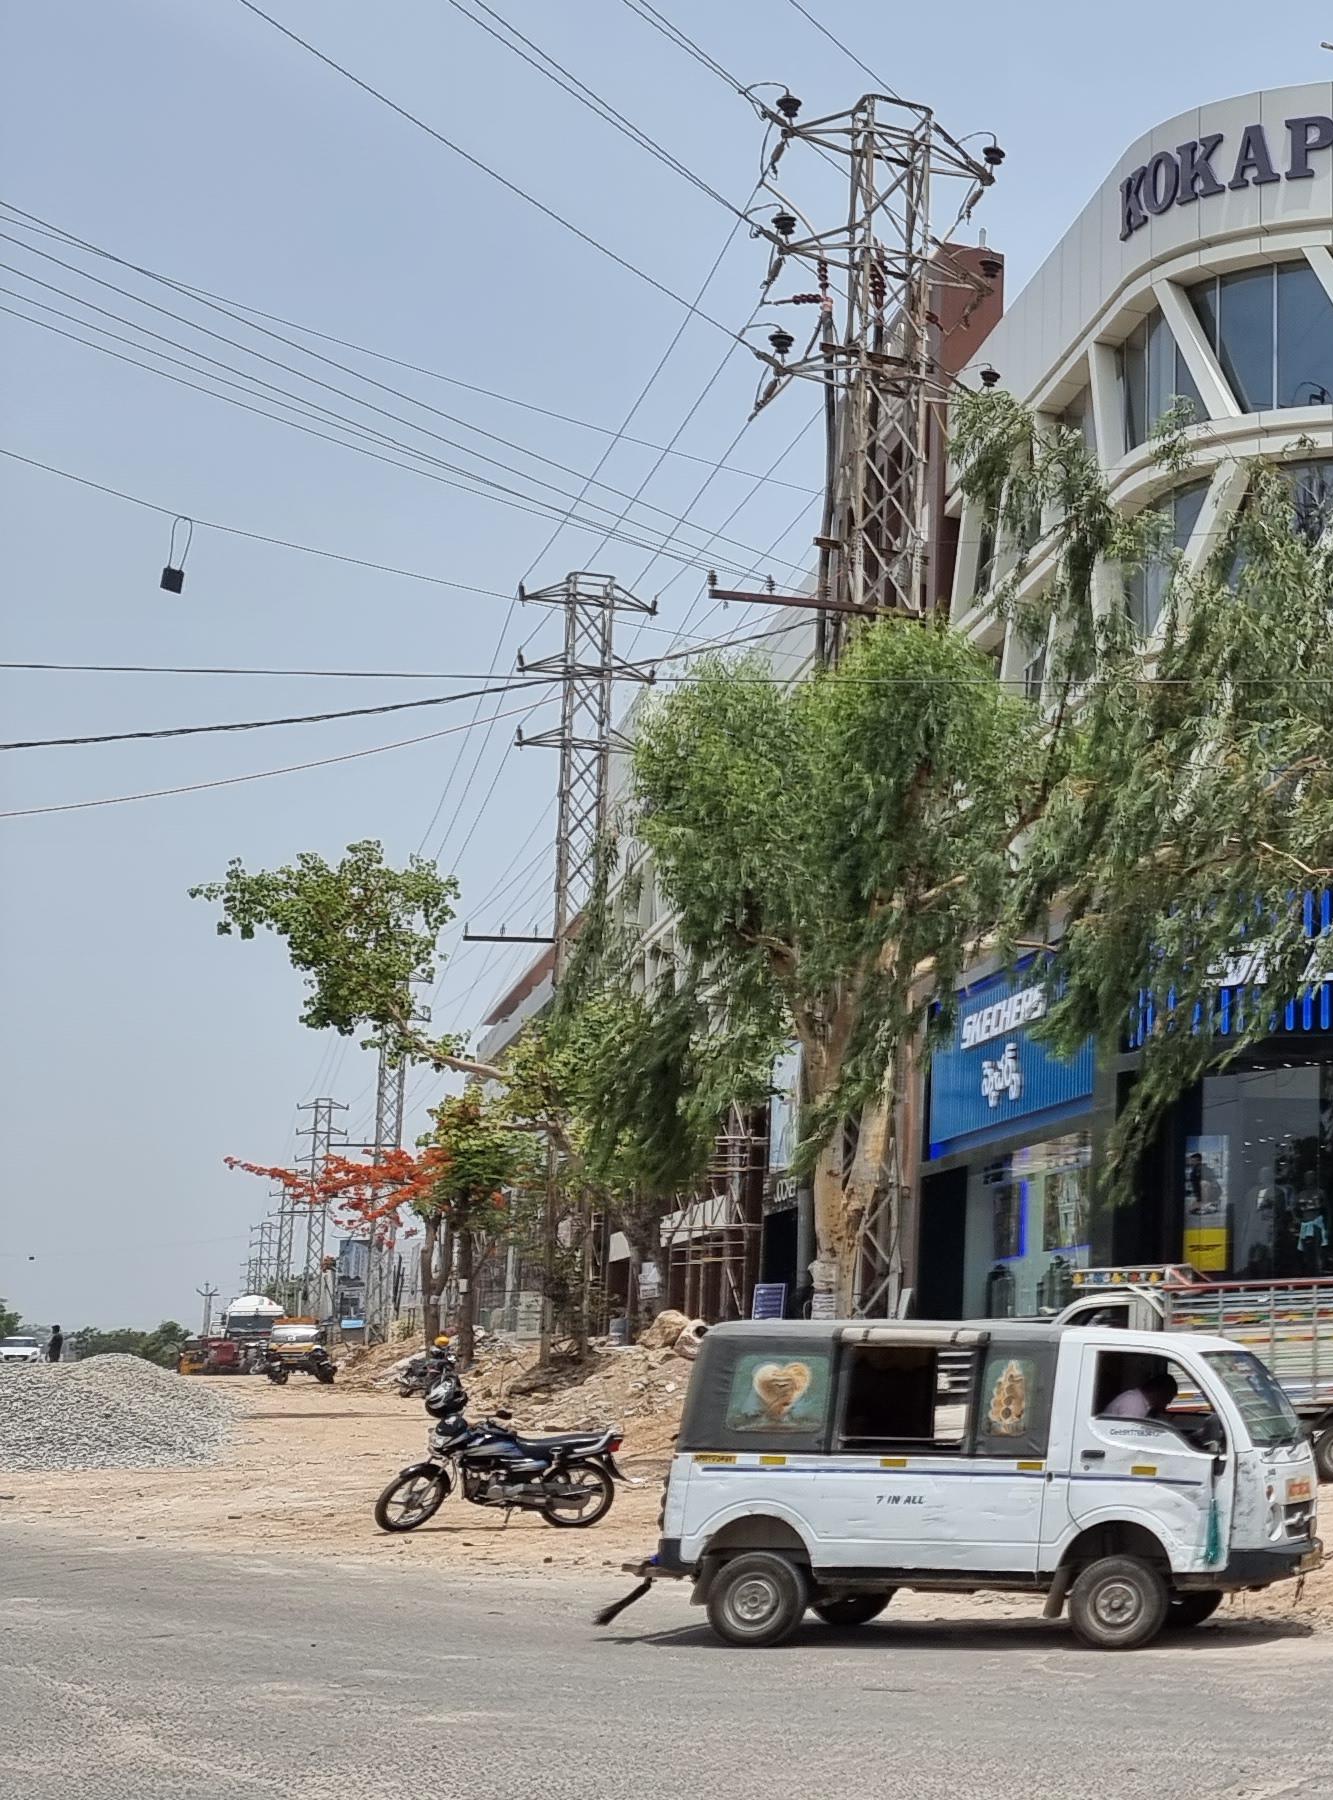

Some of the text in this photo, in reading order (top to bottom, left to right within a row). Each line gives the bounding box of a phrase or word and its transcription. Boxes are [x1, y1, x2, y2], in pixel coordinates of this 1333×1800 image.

[960, 982, 1048, 1050] SKECHERS
[876, 1496, 924, 1505] 7 IN ALL
